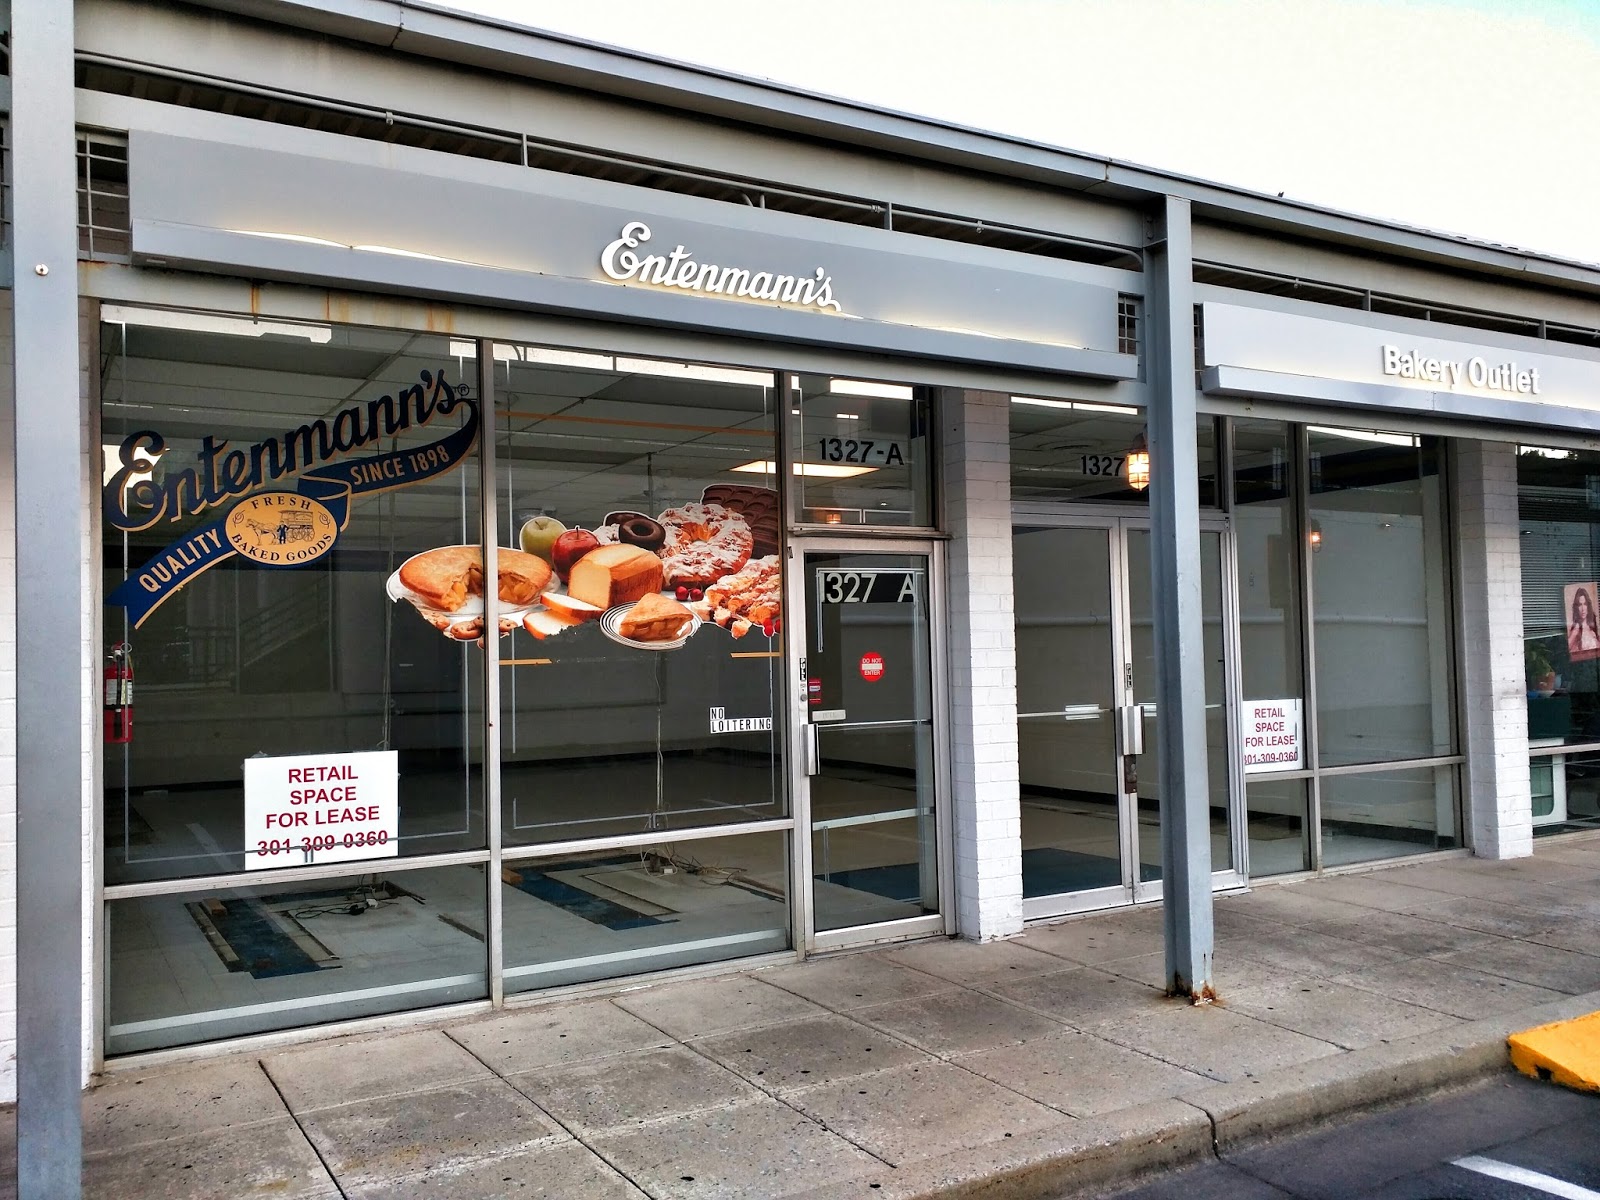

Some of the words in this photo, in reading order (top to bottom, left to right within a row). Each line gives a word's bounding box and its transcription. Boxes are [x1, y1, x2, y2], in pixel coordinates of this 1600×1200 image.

[601, 221, 842, 312] Entenmann's
[1383, 344, 1463, 389] Bakery
[1468, 356, 1541, 394] Outlet
[103, 368, 456, 532] Entenmann's
[819, 438, 905, 466] 1327-A
[350, 456, 405, 486] SINCE
[408, 444, 450, 474] 1898
[1081, 454, 1126, 477] 1327
[251, 495, 311, 510] FRESH
[232, 533, 280, 561] BAKED
[286, 533, 332, 562] GOODS
[138, 527, 223, 593] QUALITY
[897, 573, 919, 602] A
[711, 708, 724, 719] NO
[1254, 707, 1285, 718] RETAIL
[711, 718, 771, 733] LOITERING
[1255, 721, 1285, 732] SPACE
[1245, 737, 1264, 747] FOR
[1266, 735, 1295, 747] LEASE
[288, 765, 358, 784] RETAIL
[290, 786, 357, 805] SPACE
[266, 811, 308, 829] FOR
[315, 805, 380, 825] LEASE
